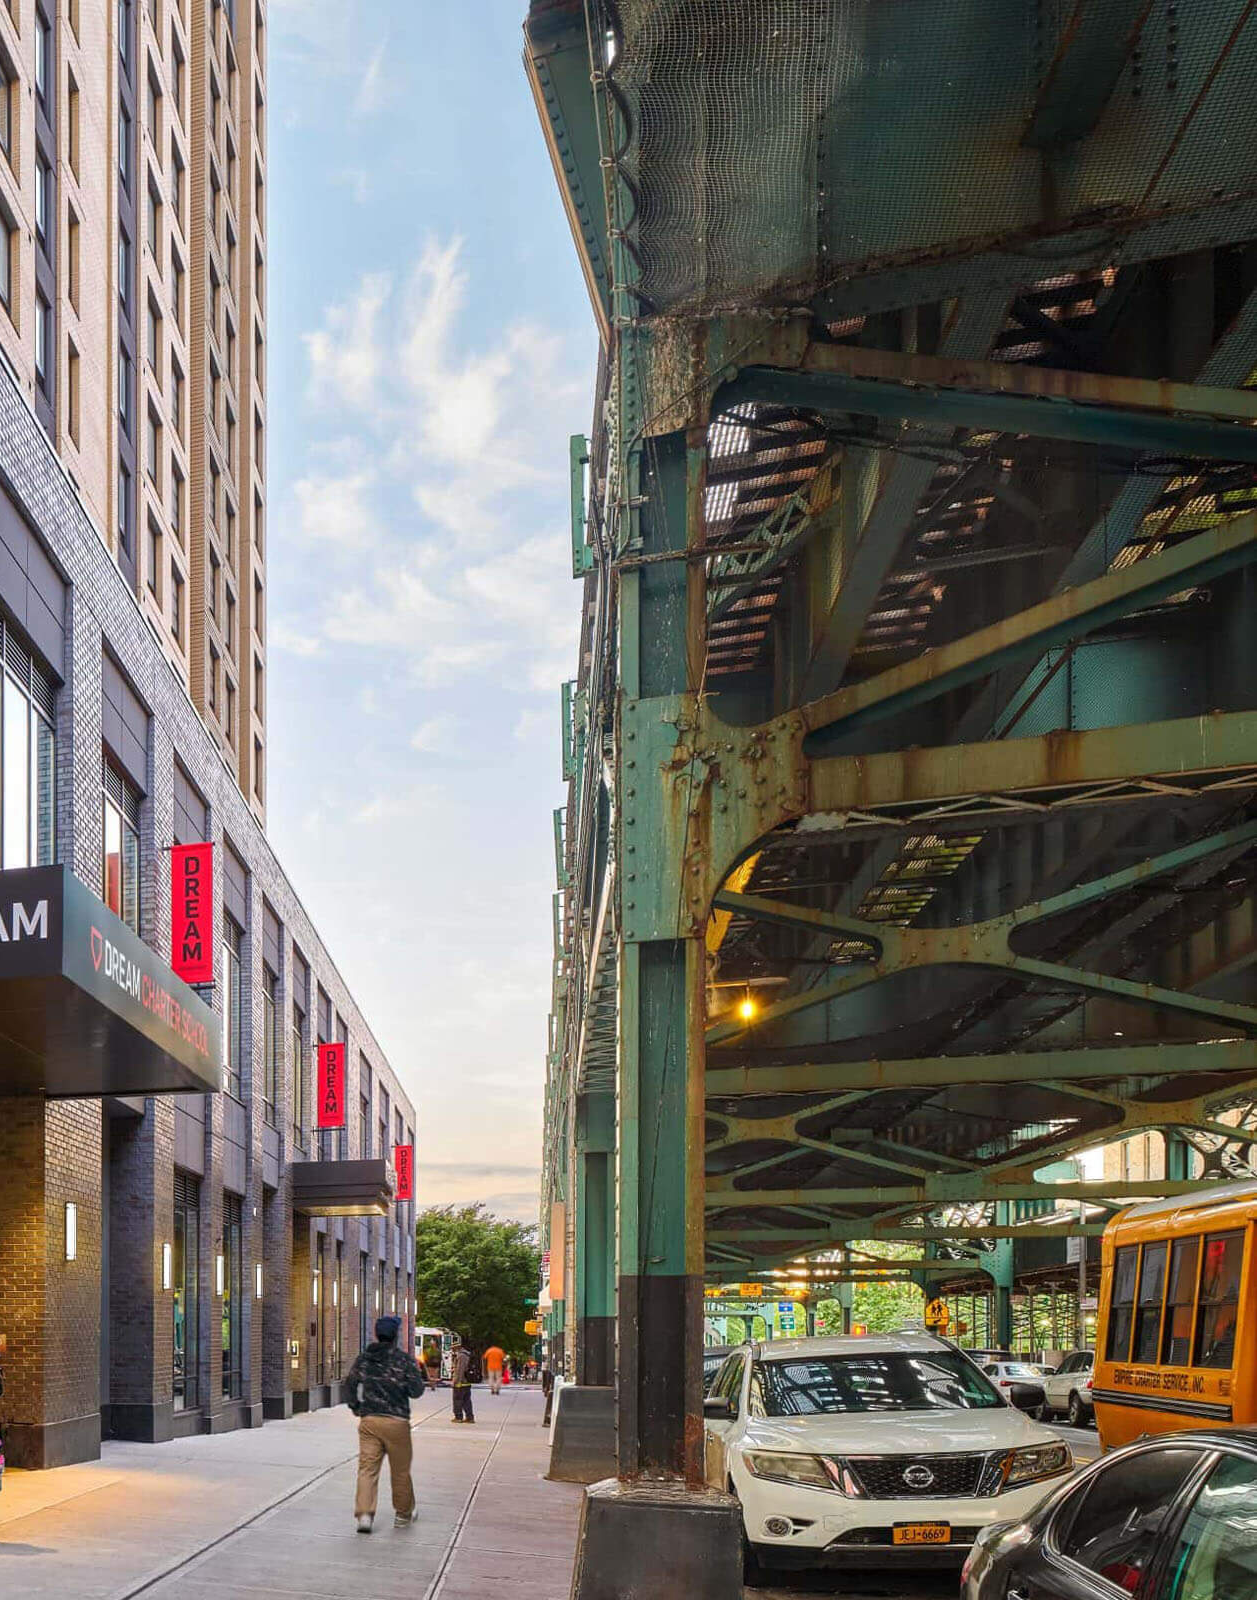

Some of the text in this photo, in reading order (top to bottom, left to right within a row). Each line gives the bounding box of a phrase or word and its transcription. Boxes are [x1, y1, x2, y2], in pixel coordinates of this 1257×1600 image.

[183, 856, 202, 963] DREAM
[104, 939, 209, 1057] DREAM CHARTER SCHOOL
[325, 1051, 338, 1114] DREAM
[399, 1149, 408, 1192] DREAM
[1114, 1369, 1133, 1386] EMPIRE
[1135, 1370, 1161, 1389] CHARTER
[1192, 1375, 1206, 1394] INC.
